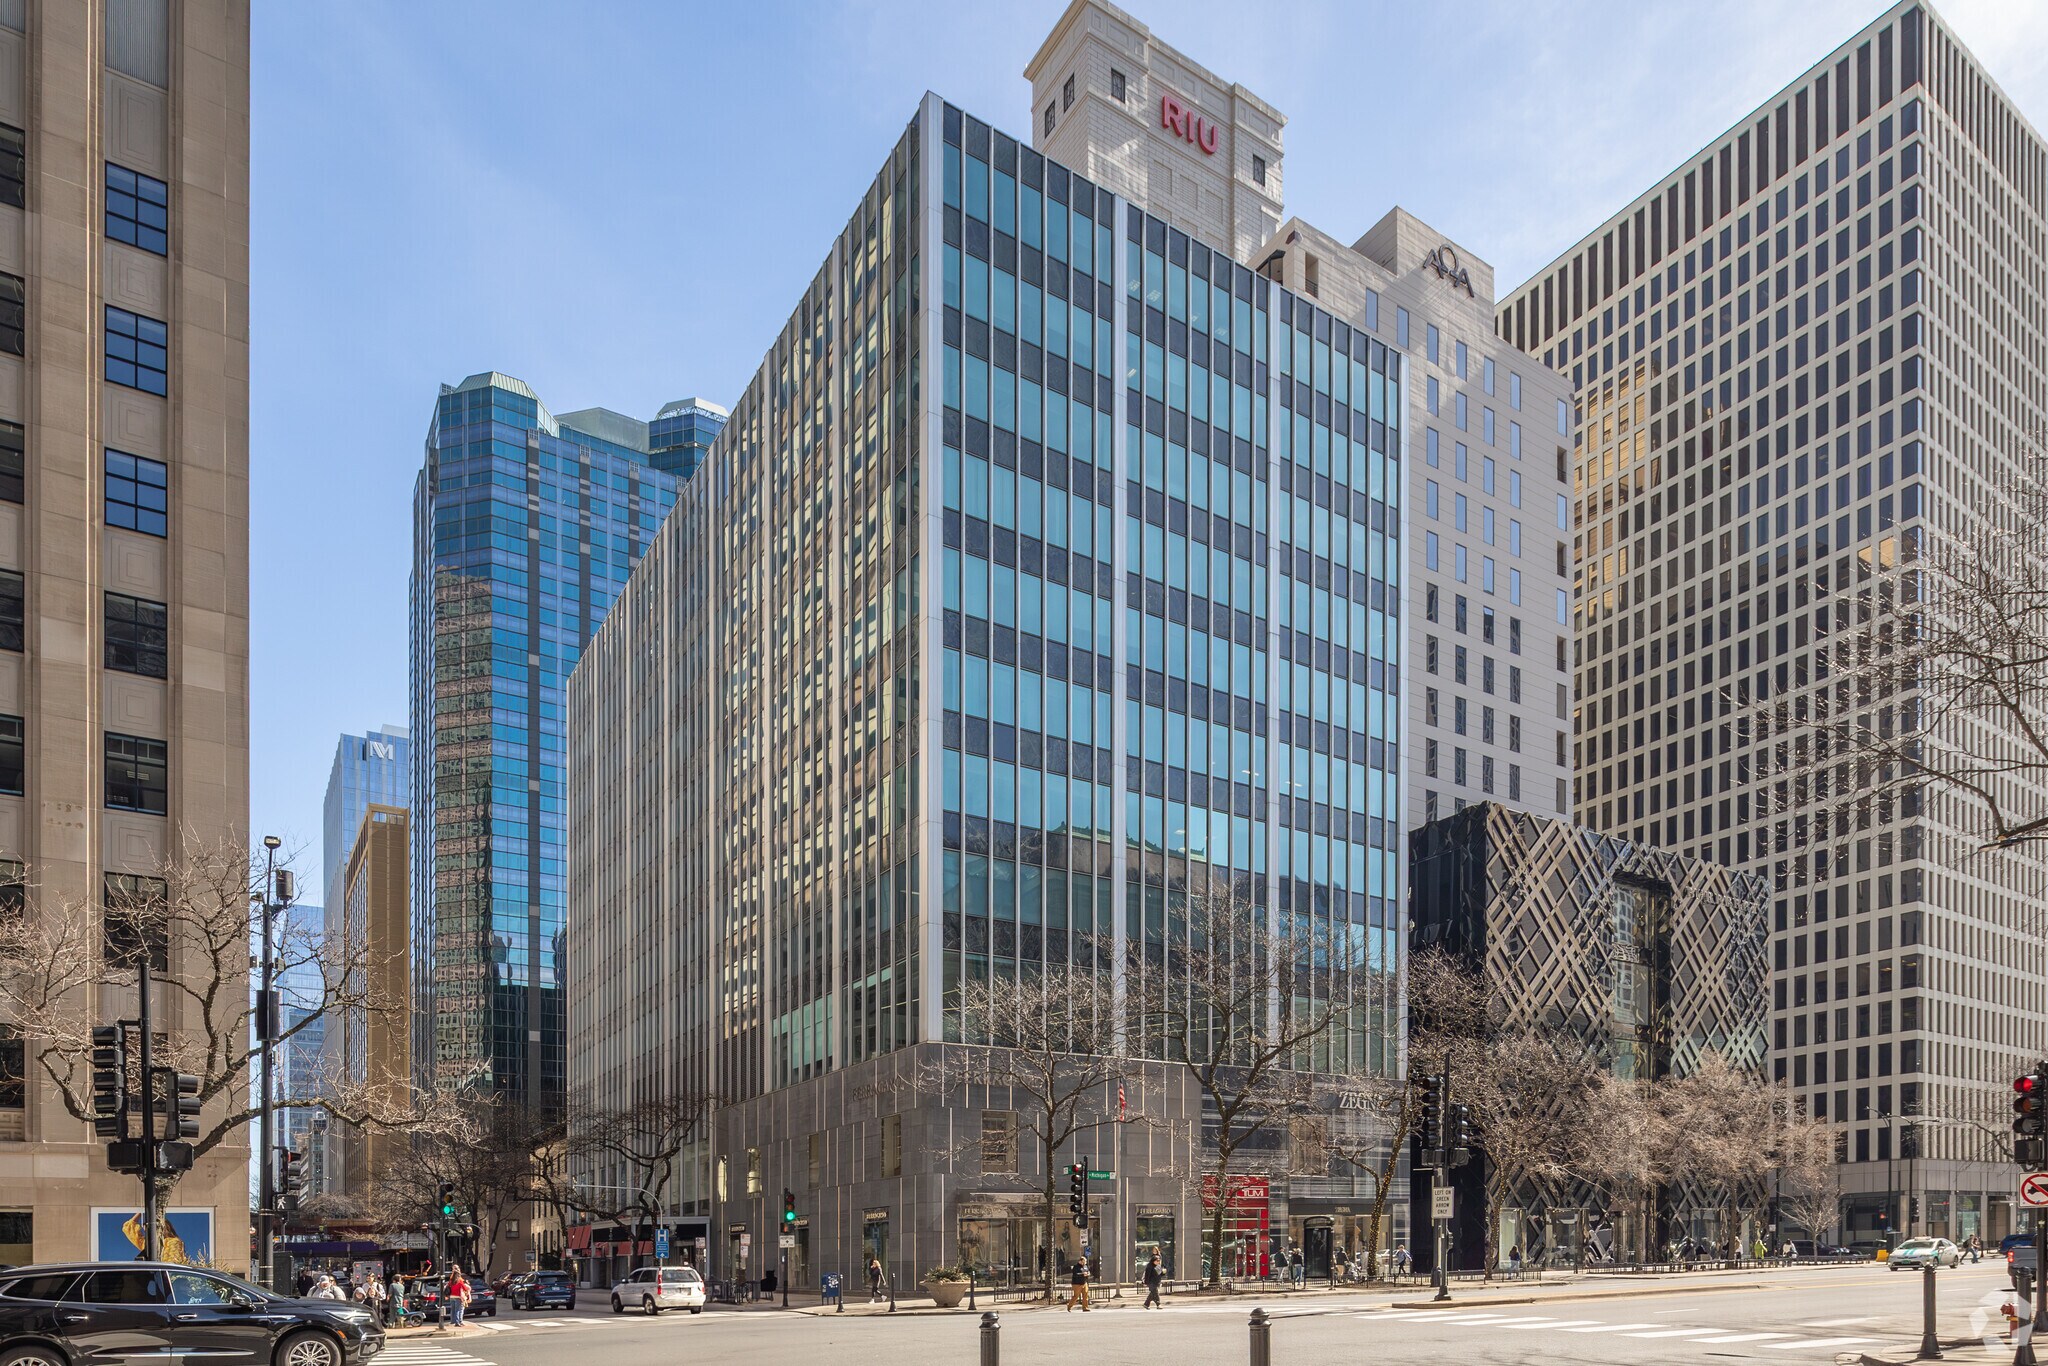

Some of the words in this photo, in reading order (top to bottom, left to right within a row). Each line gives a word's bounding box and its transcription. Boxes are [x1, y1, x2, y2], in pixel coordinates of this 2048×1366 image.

[1161, 95, 1219, 155] RIU
[1242, 1188, 1264, 1197] TUMI
[657, 1230, 667, 1242] H
